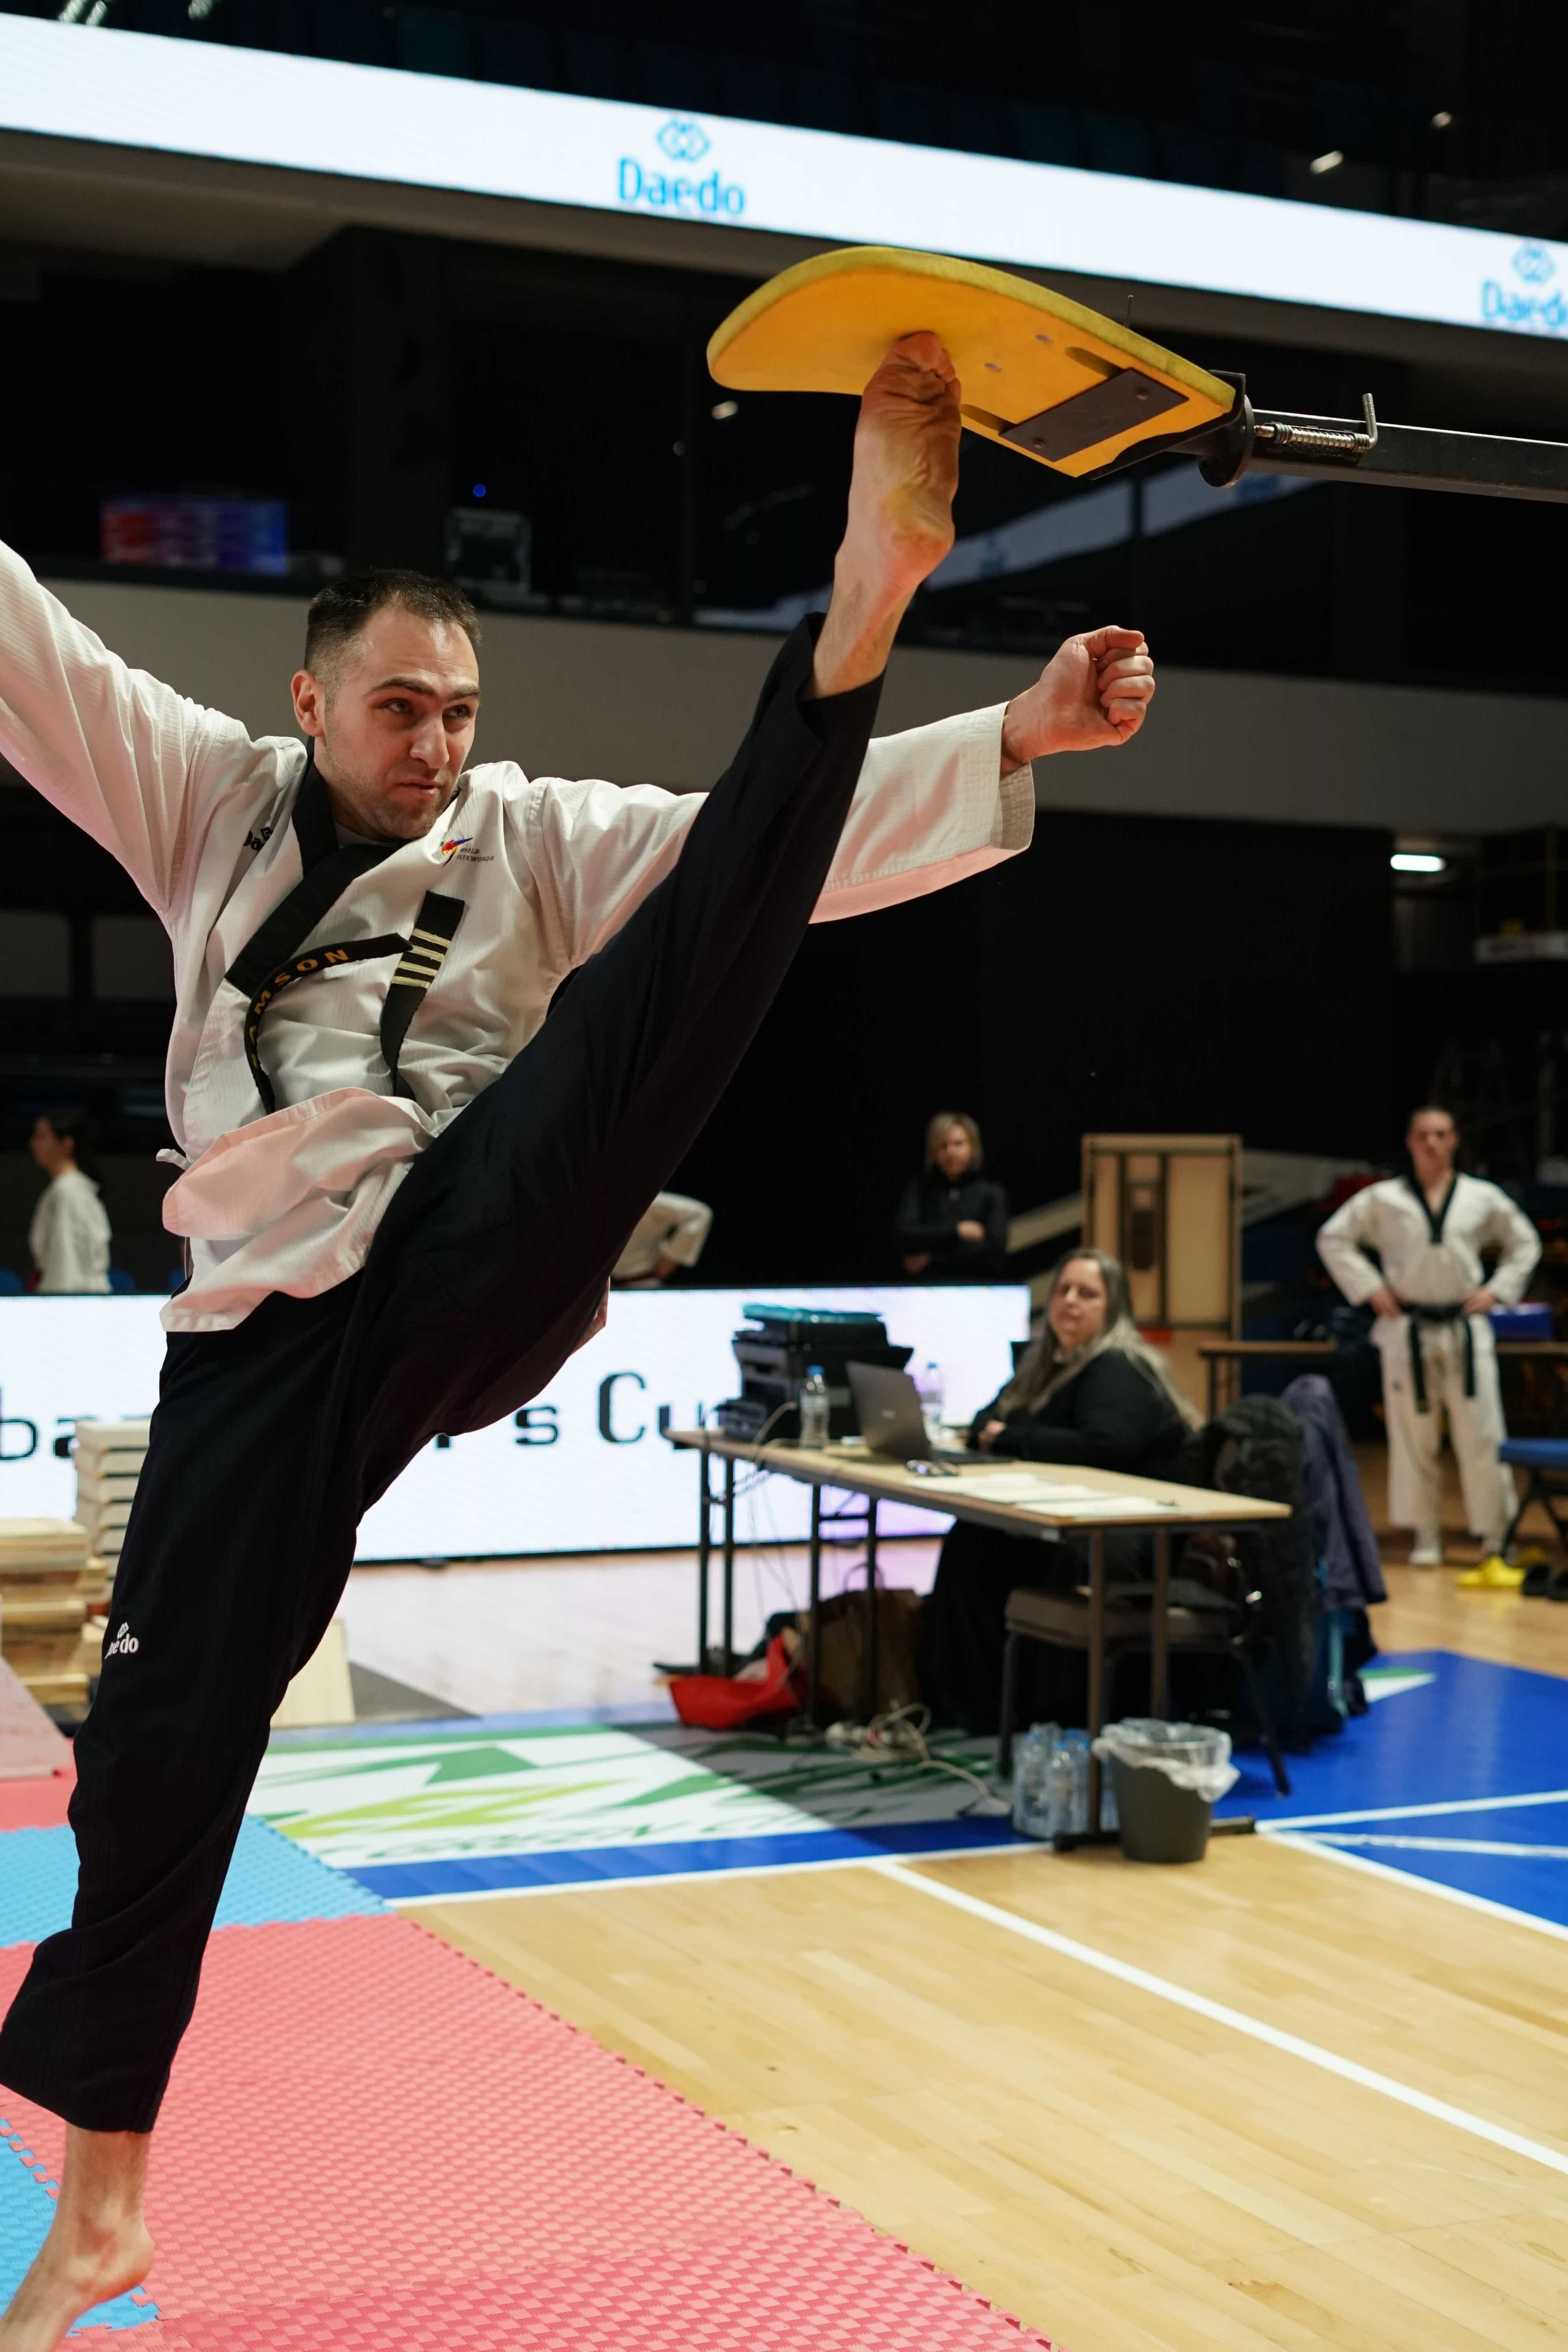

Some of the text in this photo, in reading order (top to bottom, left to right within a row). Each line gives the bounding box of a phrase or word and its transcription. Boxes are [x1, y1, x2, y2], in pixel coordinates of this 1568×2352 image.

[619, 156, 745, 216] Daedo
[1482, 279, 1568, 328] Daed
[598, 1371, 723, 1450] Cu
